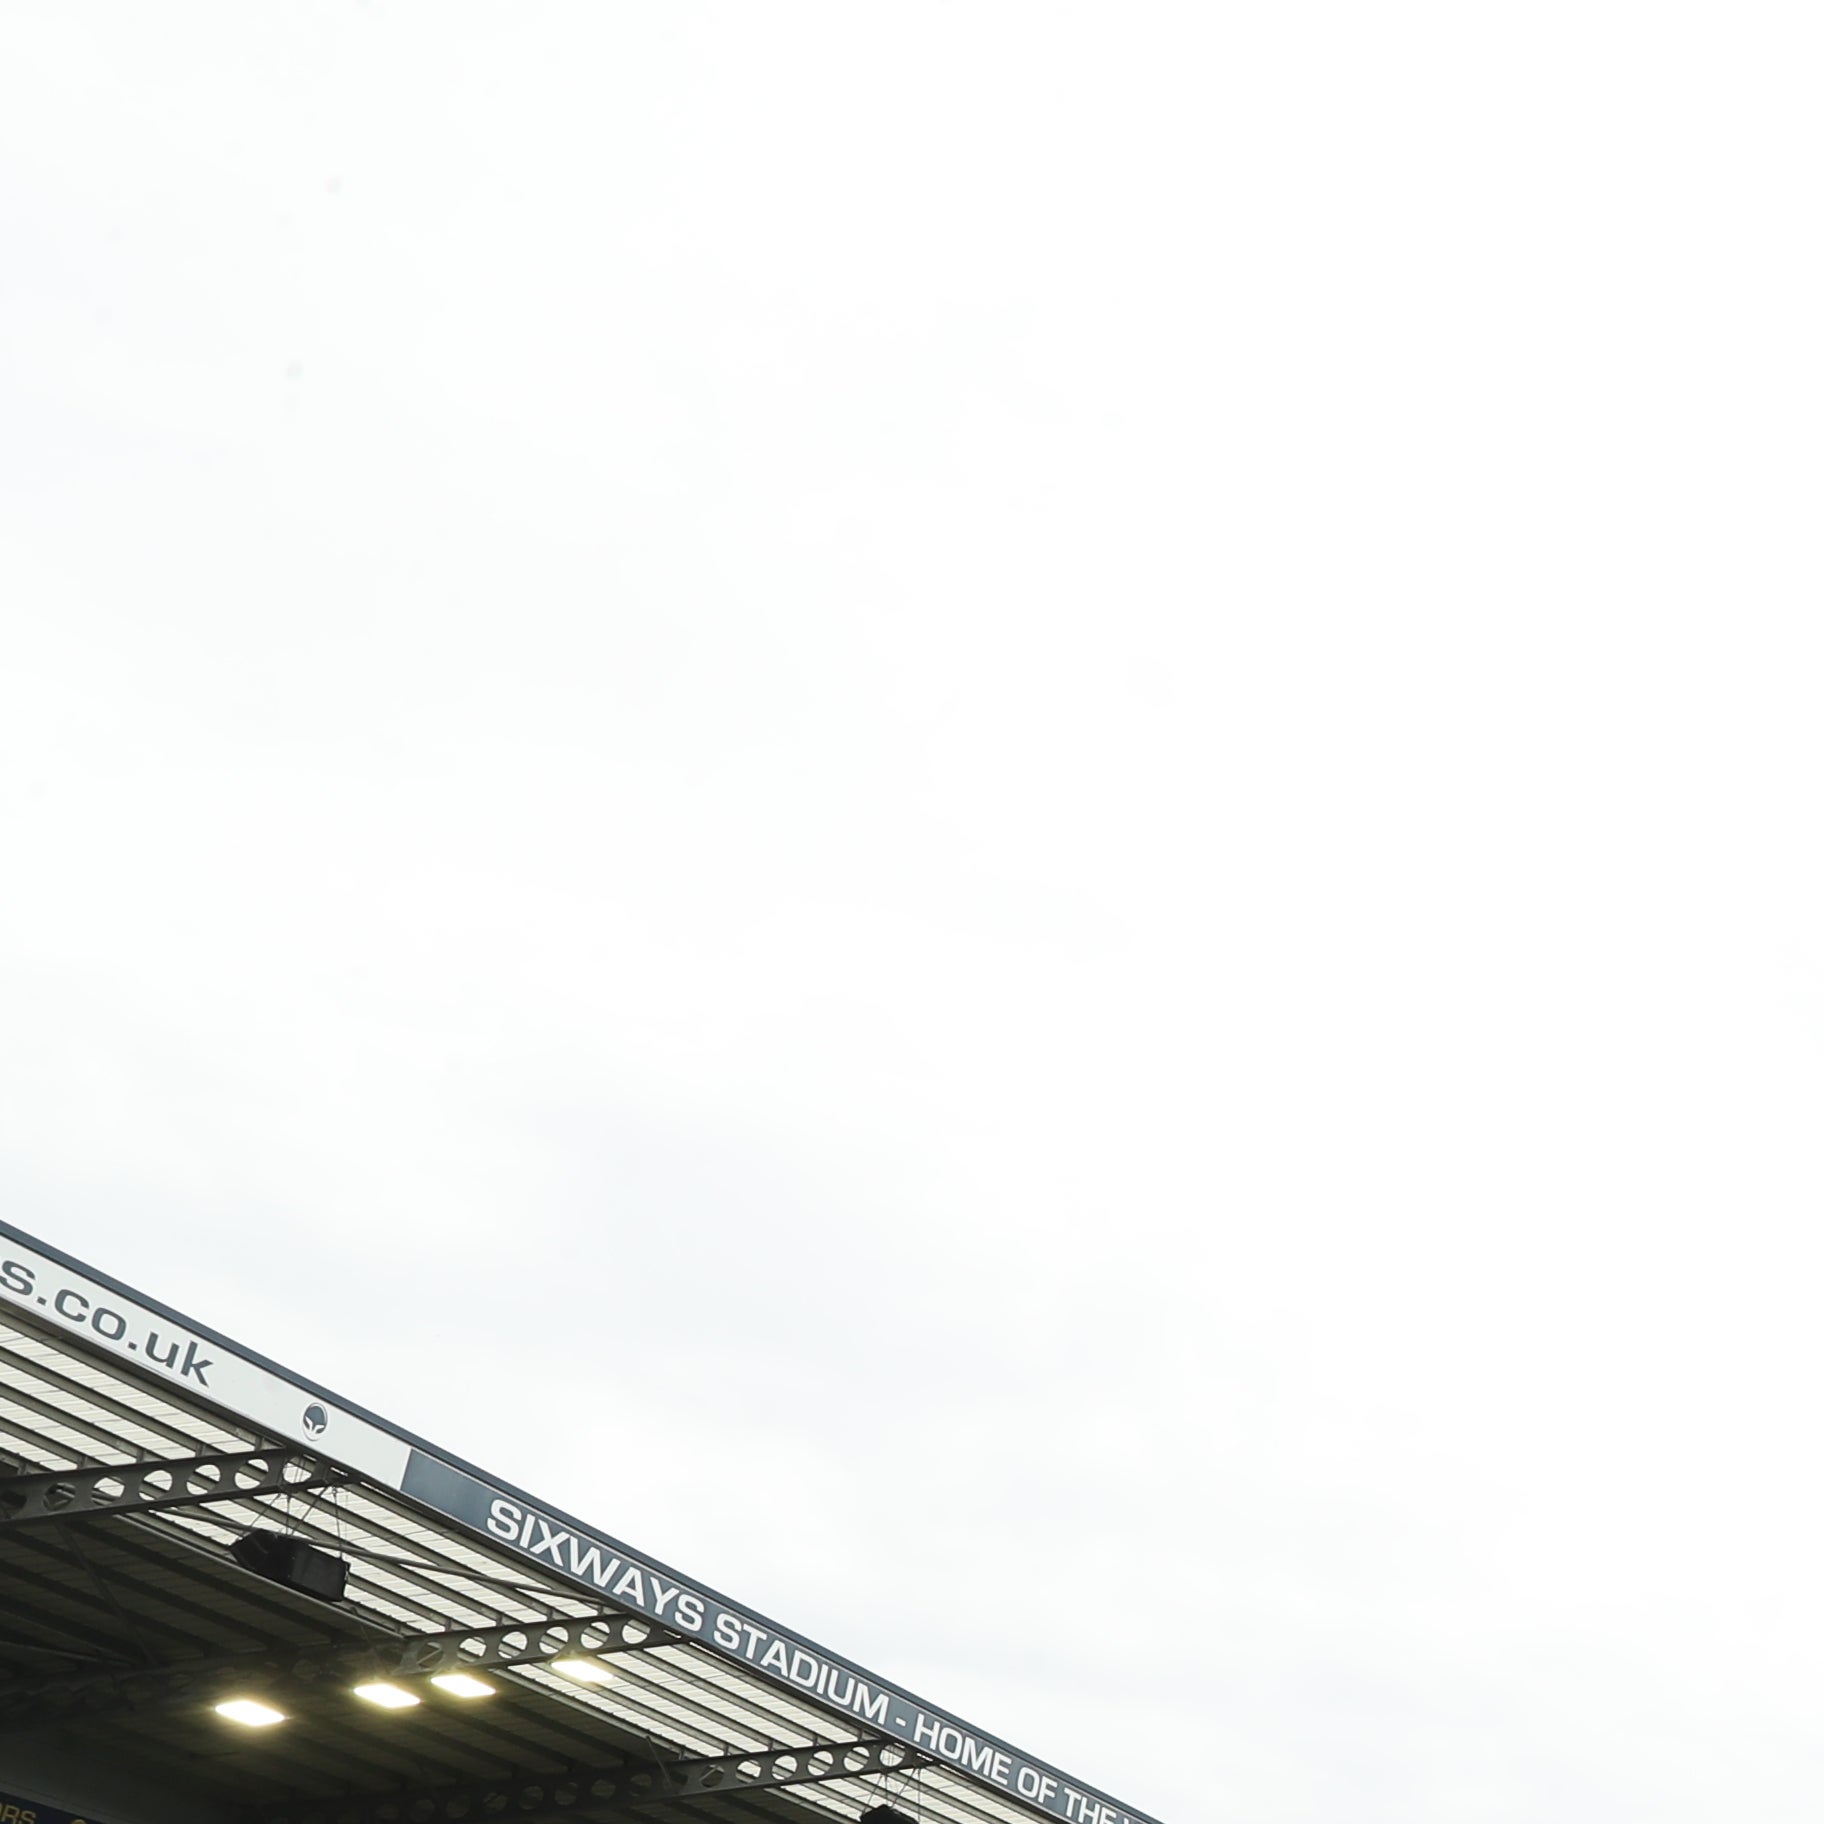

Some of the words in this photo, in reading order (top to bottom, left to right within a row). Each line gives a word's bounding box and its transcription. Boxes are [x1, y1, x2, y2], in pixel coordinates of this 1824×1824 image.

[487, 1499, 705, 1632] SIXWAYS
[713, 1612, 890, 1724] STADIUM
[913, 1713, 1012, 1786] HOME
[1017, 1766, 1056, 1804] OF
